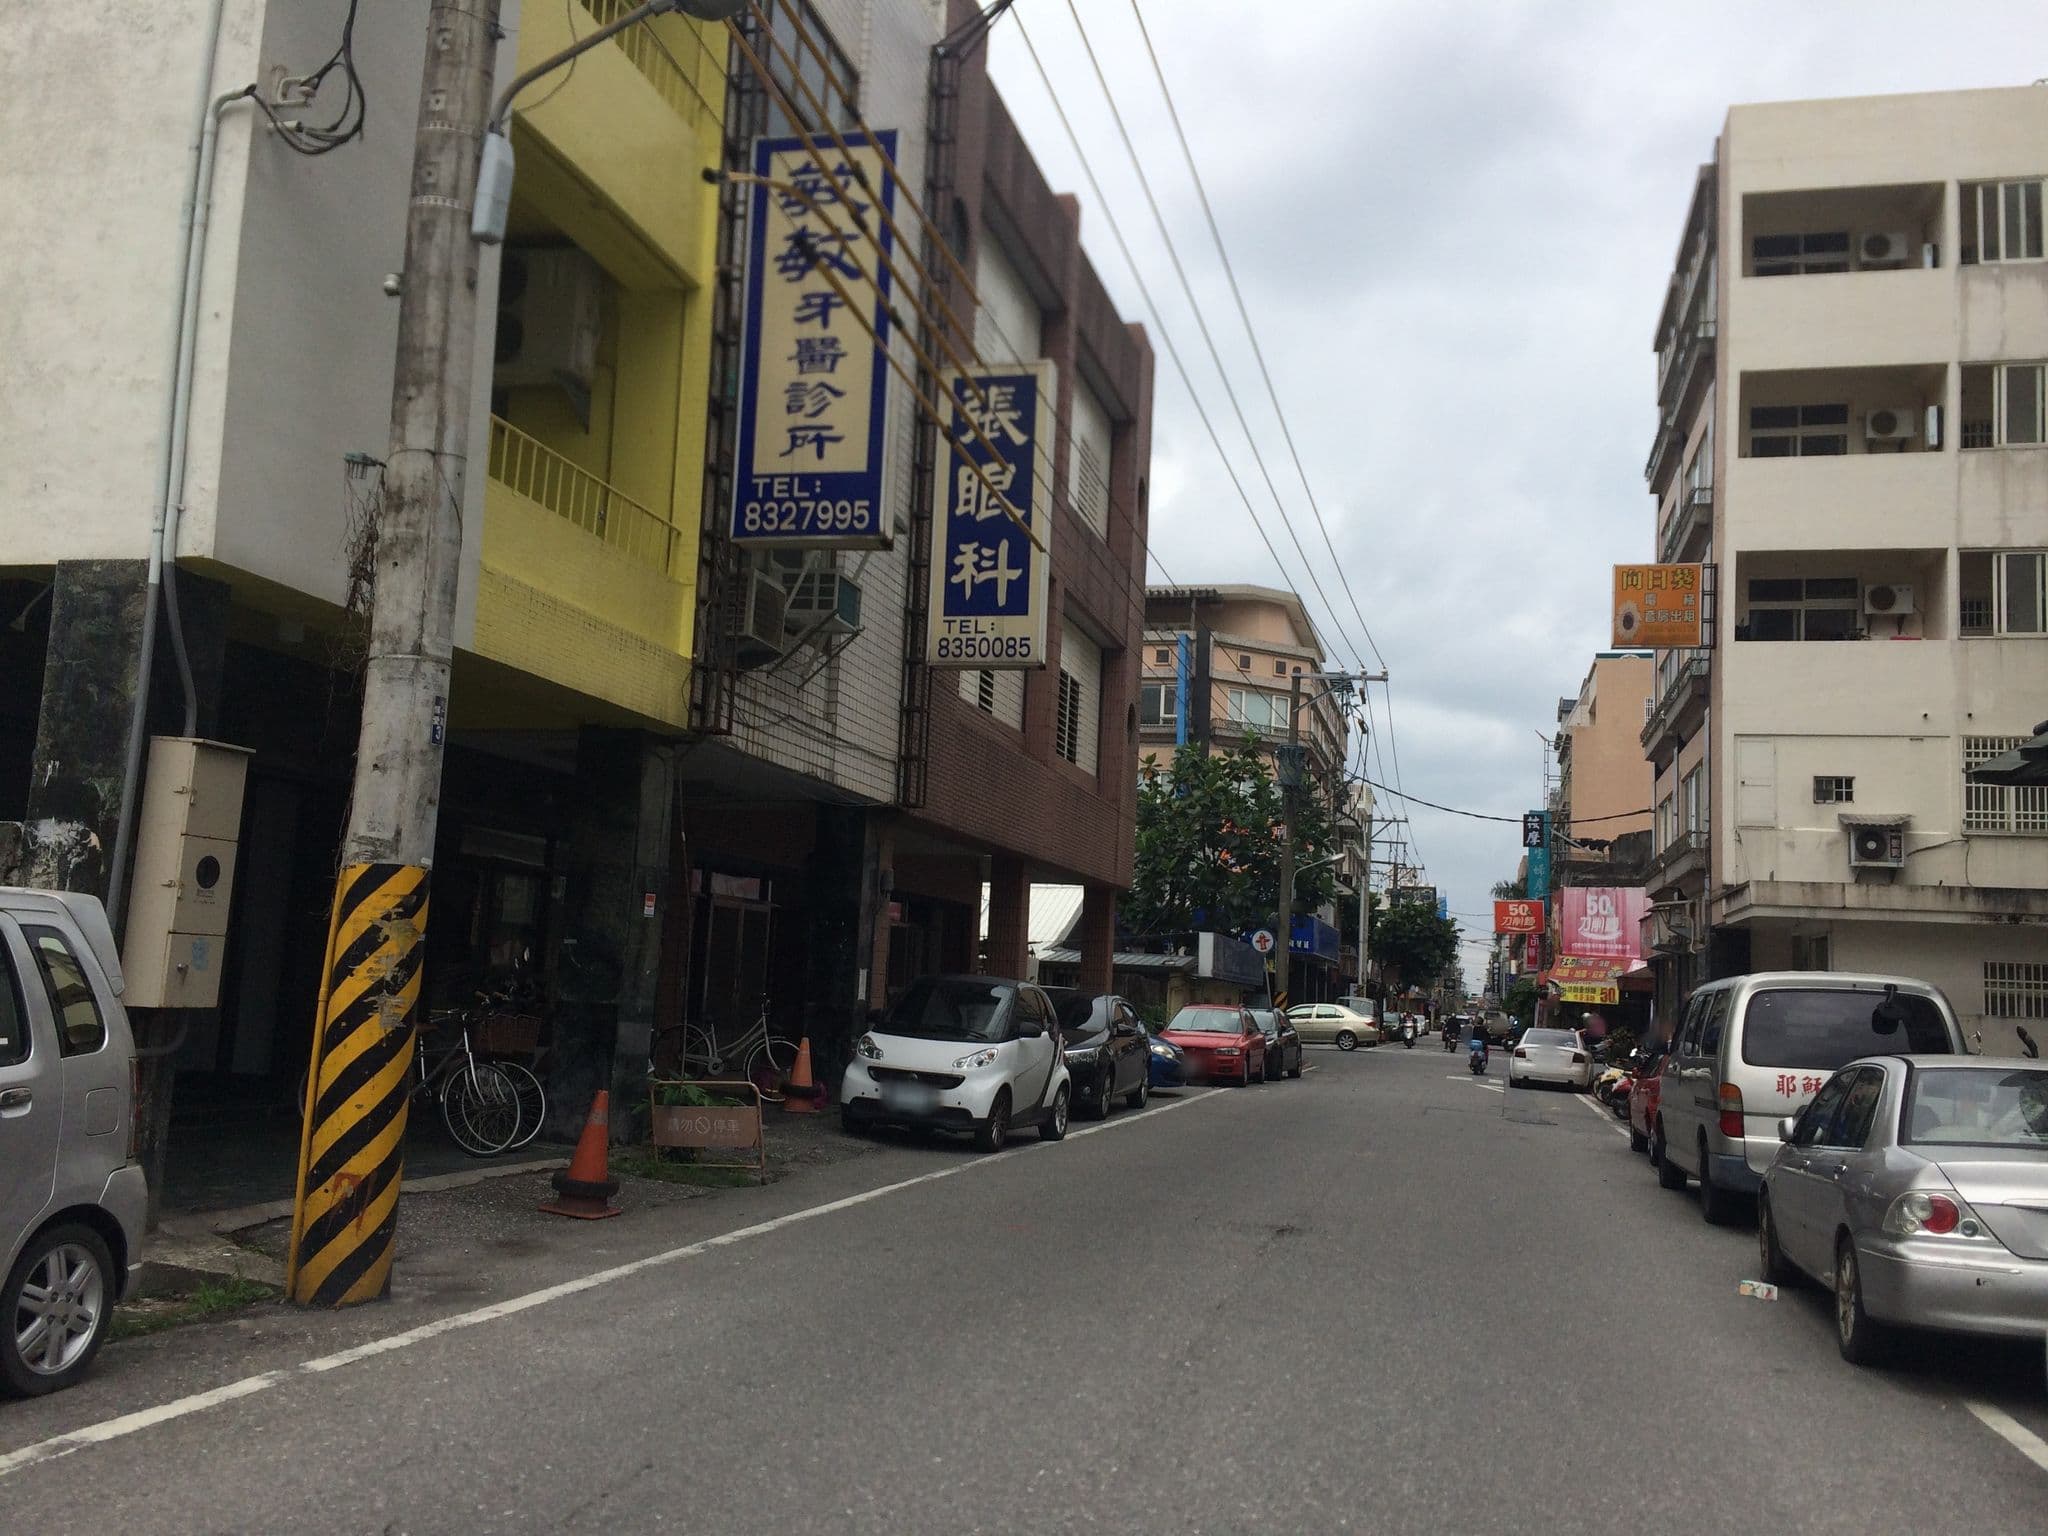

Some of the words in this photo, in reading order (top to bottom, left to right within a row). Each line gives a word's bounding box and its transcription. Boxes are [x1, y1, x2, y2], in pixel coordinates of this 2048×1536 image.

[752, 478, 821, 498] TEL:
[950, 384, 1029, 607] 張眼科
[744, 501, 870, 530] 8327995
[1621, 568, 1696, 590] 向日葵
[943, 620, 996, 634] TEL:
[938, 638, 1031, 658] 8350085
[1526, 815, 1541, 846] 按摩
